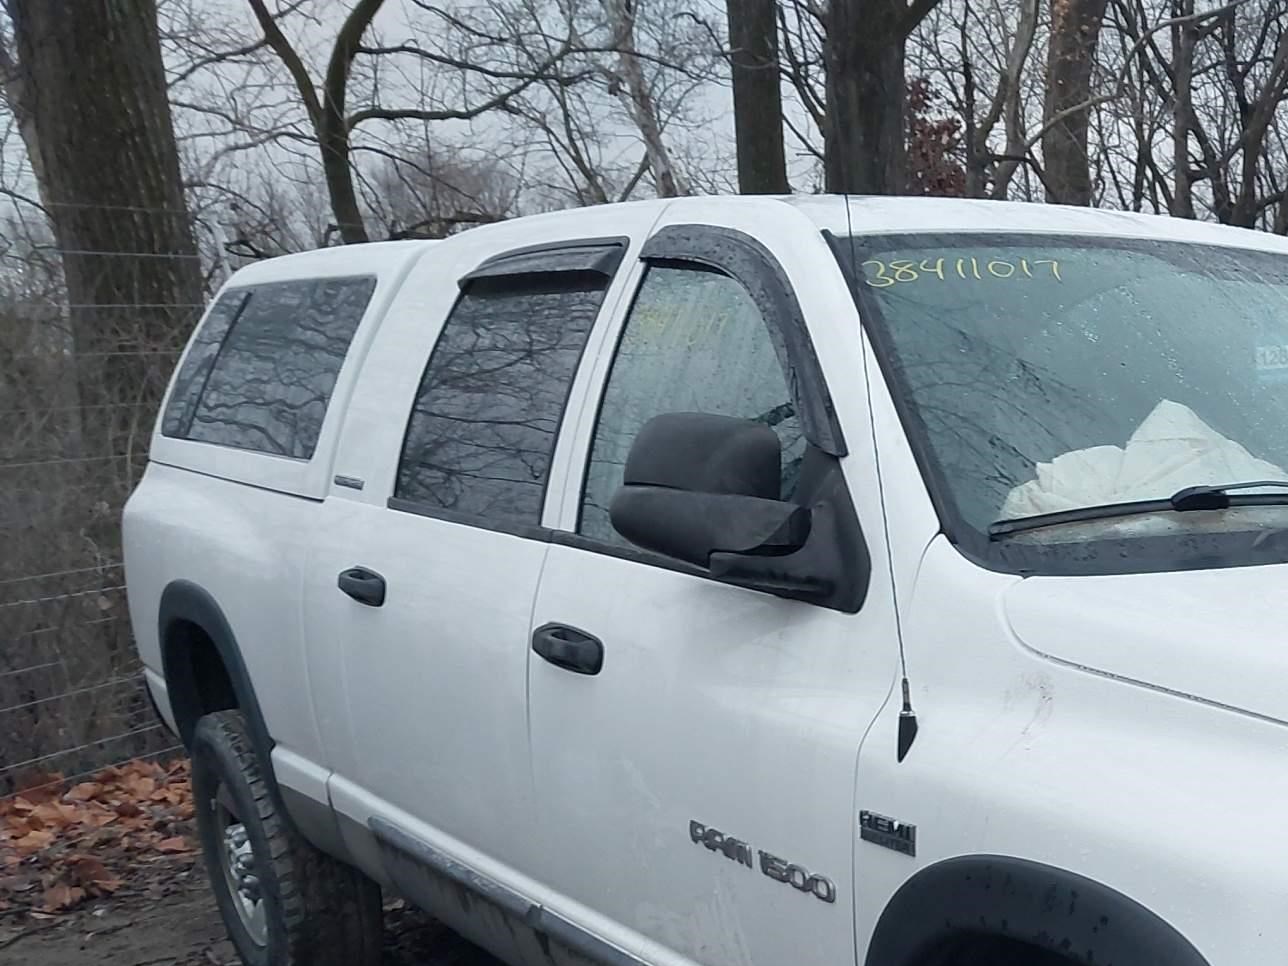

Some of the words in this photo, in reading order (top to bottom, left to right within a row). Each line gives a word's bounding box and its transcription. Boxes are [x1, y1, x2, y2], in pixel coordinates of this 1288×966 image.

[861, 257, 1063, 288] 38411017
[689, 819, 754, 869] RAM
[757, 849, 837, 904] 1500
